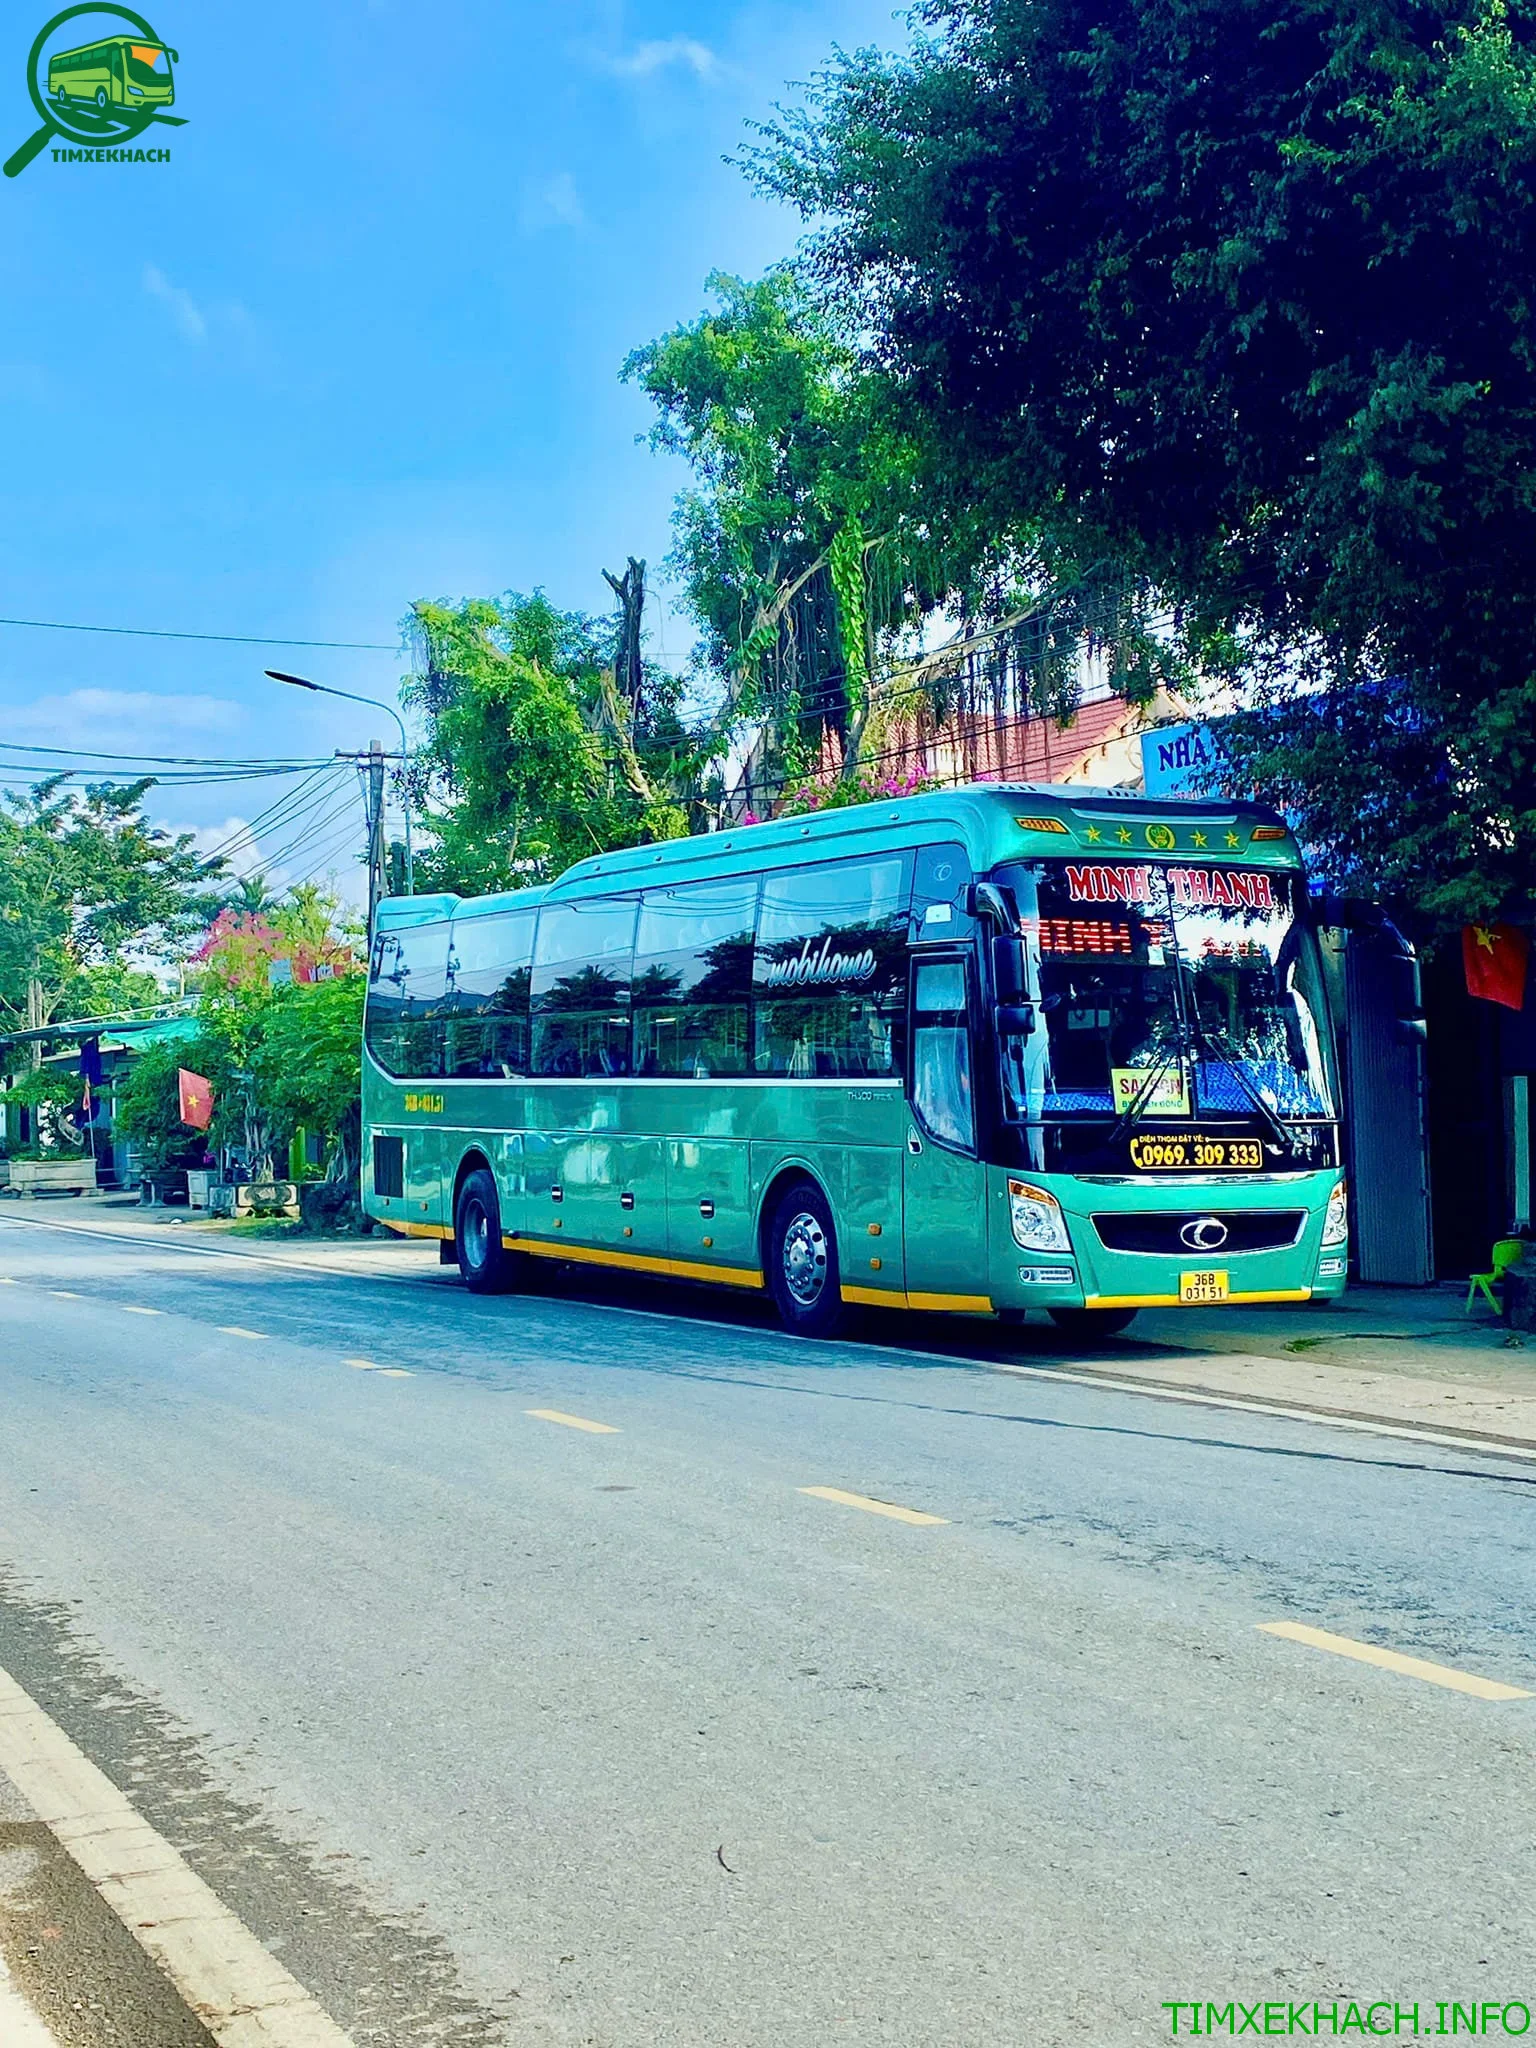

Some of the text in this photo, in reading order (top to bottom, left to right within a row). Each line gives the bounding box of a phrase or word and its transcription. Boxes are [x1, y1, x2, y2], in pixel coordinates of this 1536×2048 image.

[1066, 865, 1273, 908] MINH THANH
[768, 936, 877, 988] mobihome
[1143, 1145, 1259, 1165] 0969. 309 333
[1194, 1273, 1215, 1285] 36B
